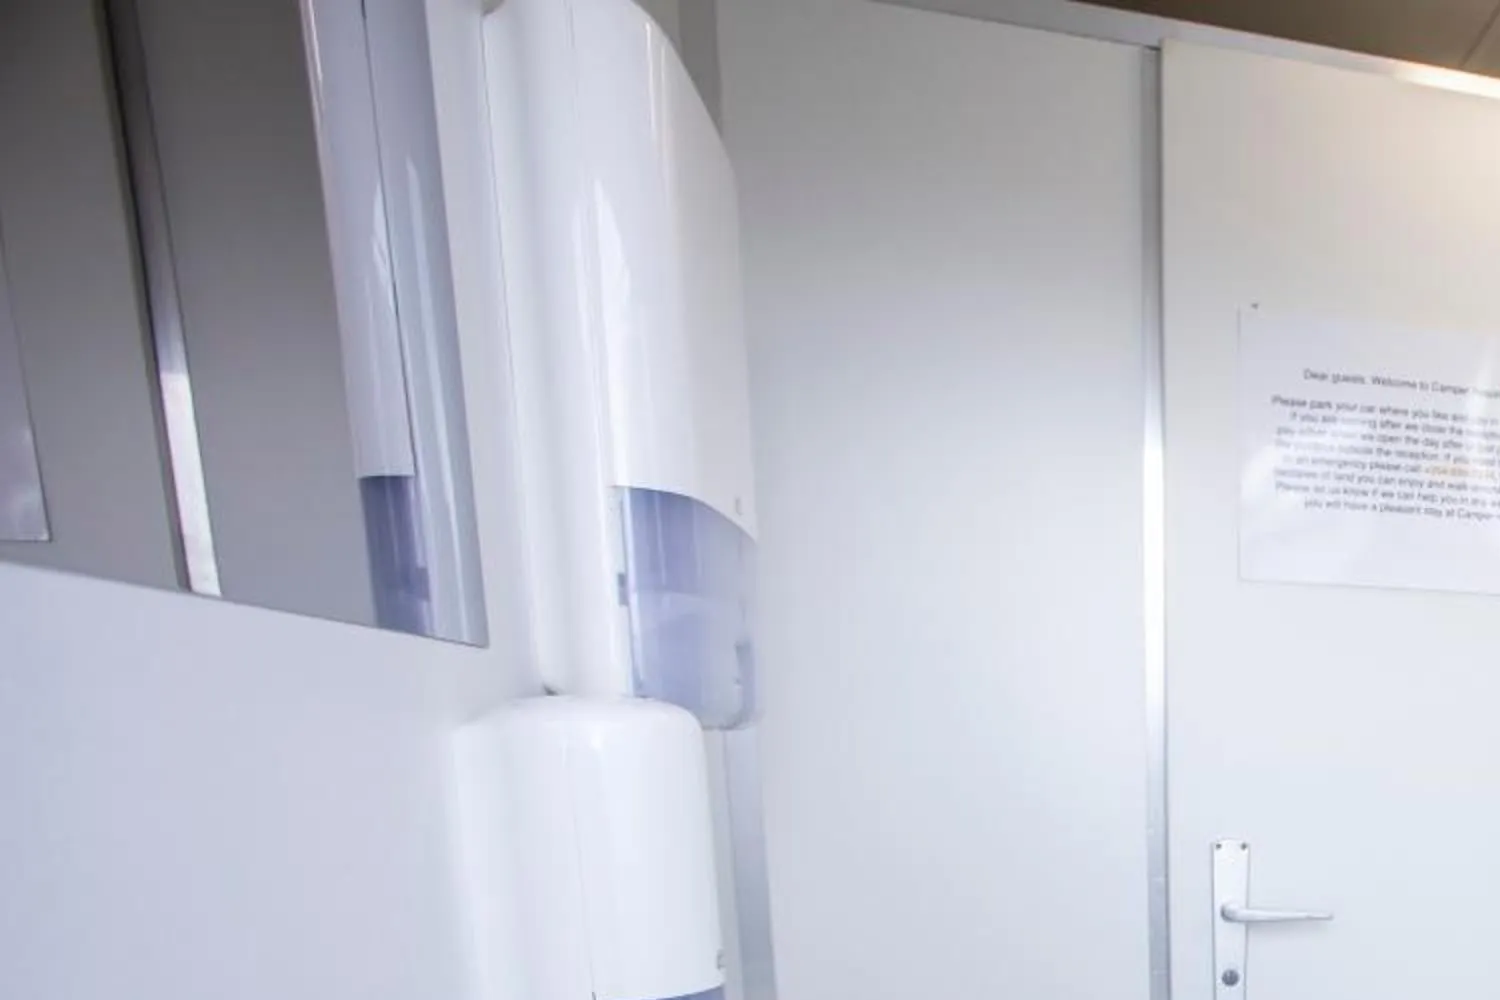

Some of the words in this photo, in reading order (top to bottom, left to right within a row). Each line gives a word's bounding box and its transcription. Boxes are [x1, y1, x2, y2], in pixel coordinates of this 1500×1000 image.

[1371, 375, 1416, 388] Welcome
[1419, 380, 1428, 389] to
[1271, 394, 1306, 406] Please
[1309, 399, 1331, 410] park
[1336, 401, 1357, 412] your
[1359, 404, 1375, 413] car
[1379, 405, 1408, 416] where
[1412, 409, 1428, 419] you
[1432, 409, 1448, 419] like
[1404, 435, 1419, 445] the
[1422, 437, 1438, 448] day
[1376, 447, 1391, 456] the
[1311, 456, 1366, 471] emergency
[1369, 460, 1399, 472] please
[1428, 479, 1444, 488] and
[1448, 481, 1467, 490] walk
[1343, 487, 1368, 496] know
